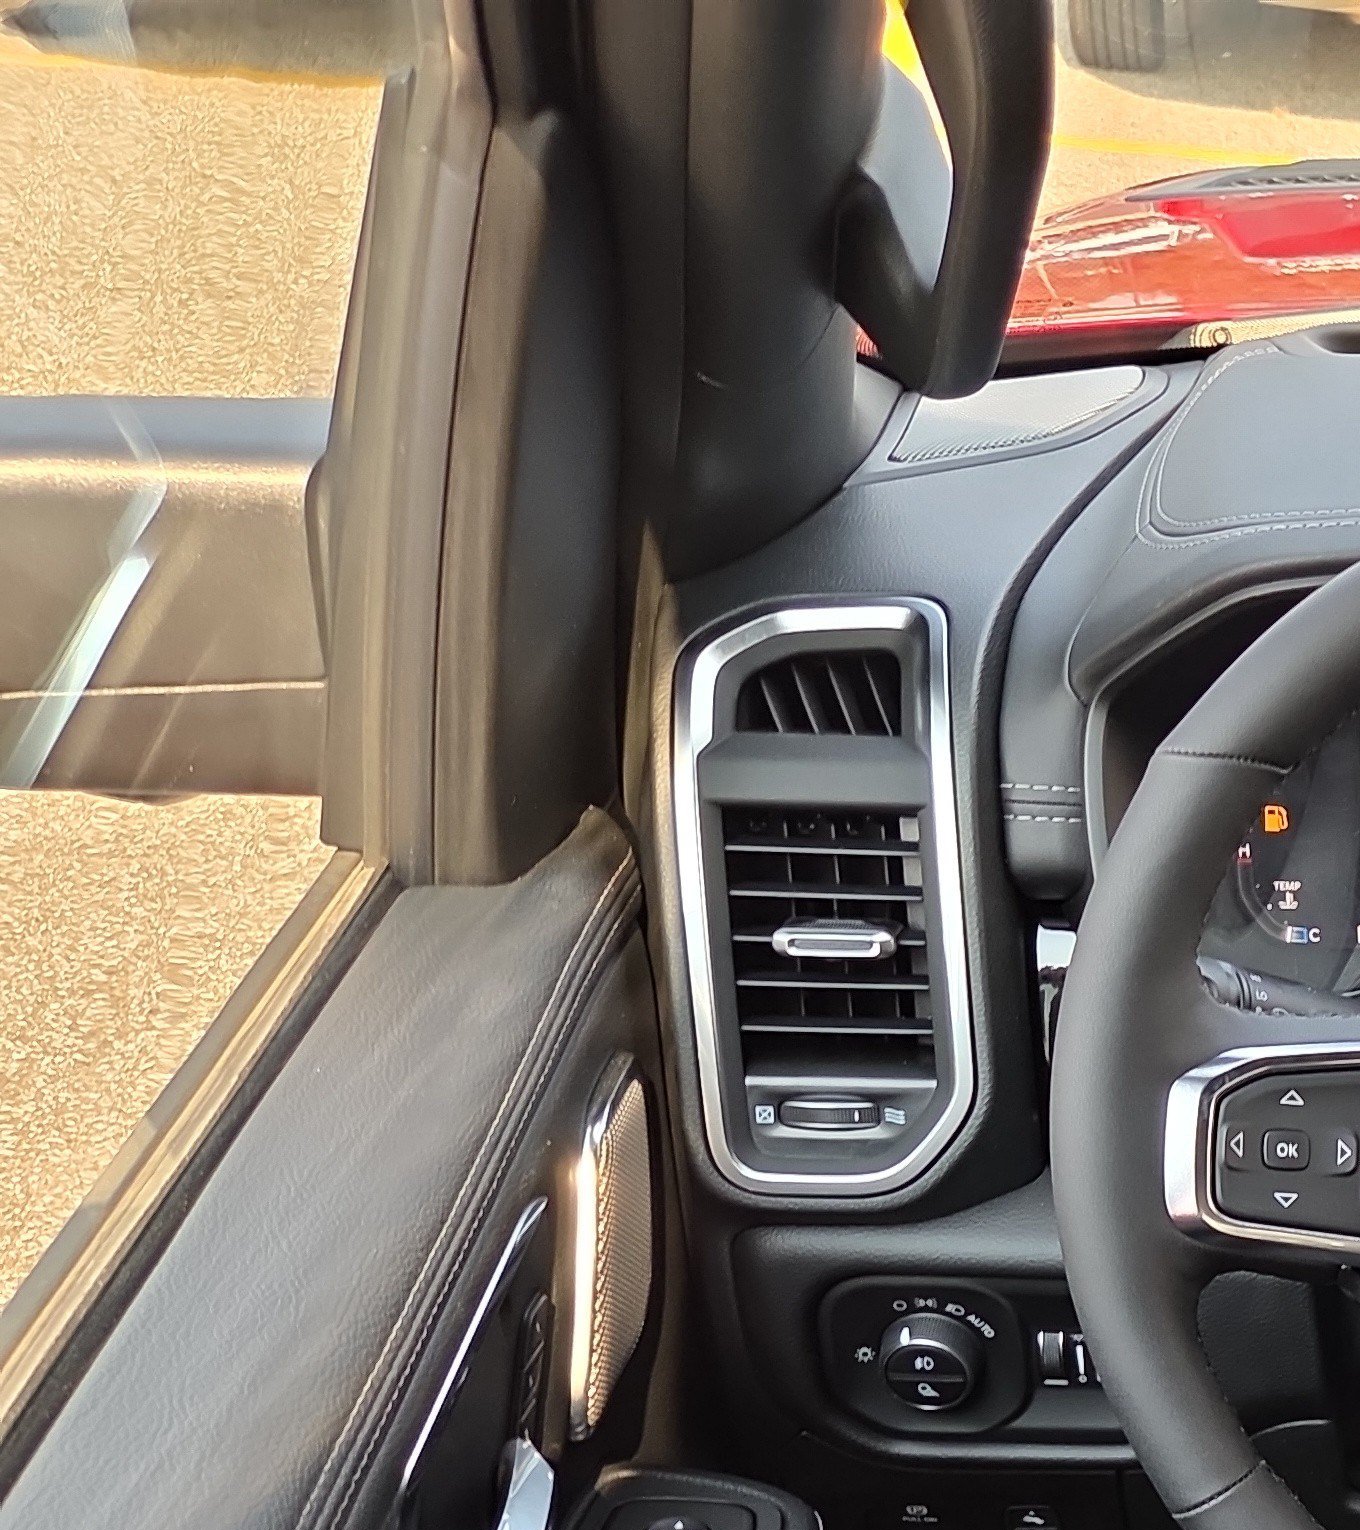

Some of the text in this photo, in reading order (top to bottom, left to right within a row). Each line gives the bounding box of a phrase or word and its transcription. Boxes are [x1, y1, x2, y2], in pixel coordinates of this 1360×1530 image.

[1272, 880, 1302, 892] TEMP
[1308, 926, 1321, 943] C
[1275, 1140, 1300, 1159] OK
[966, 1314, 996, 1339] AUTO
